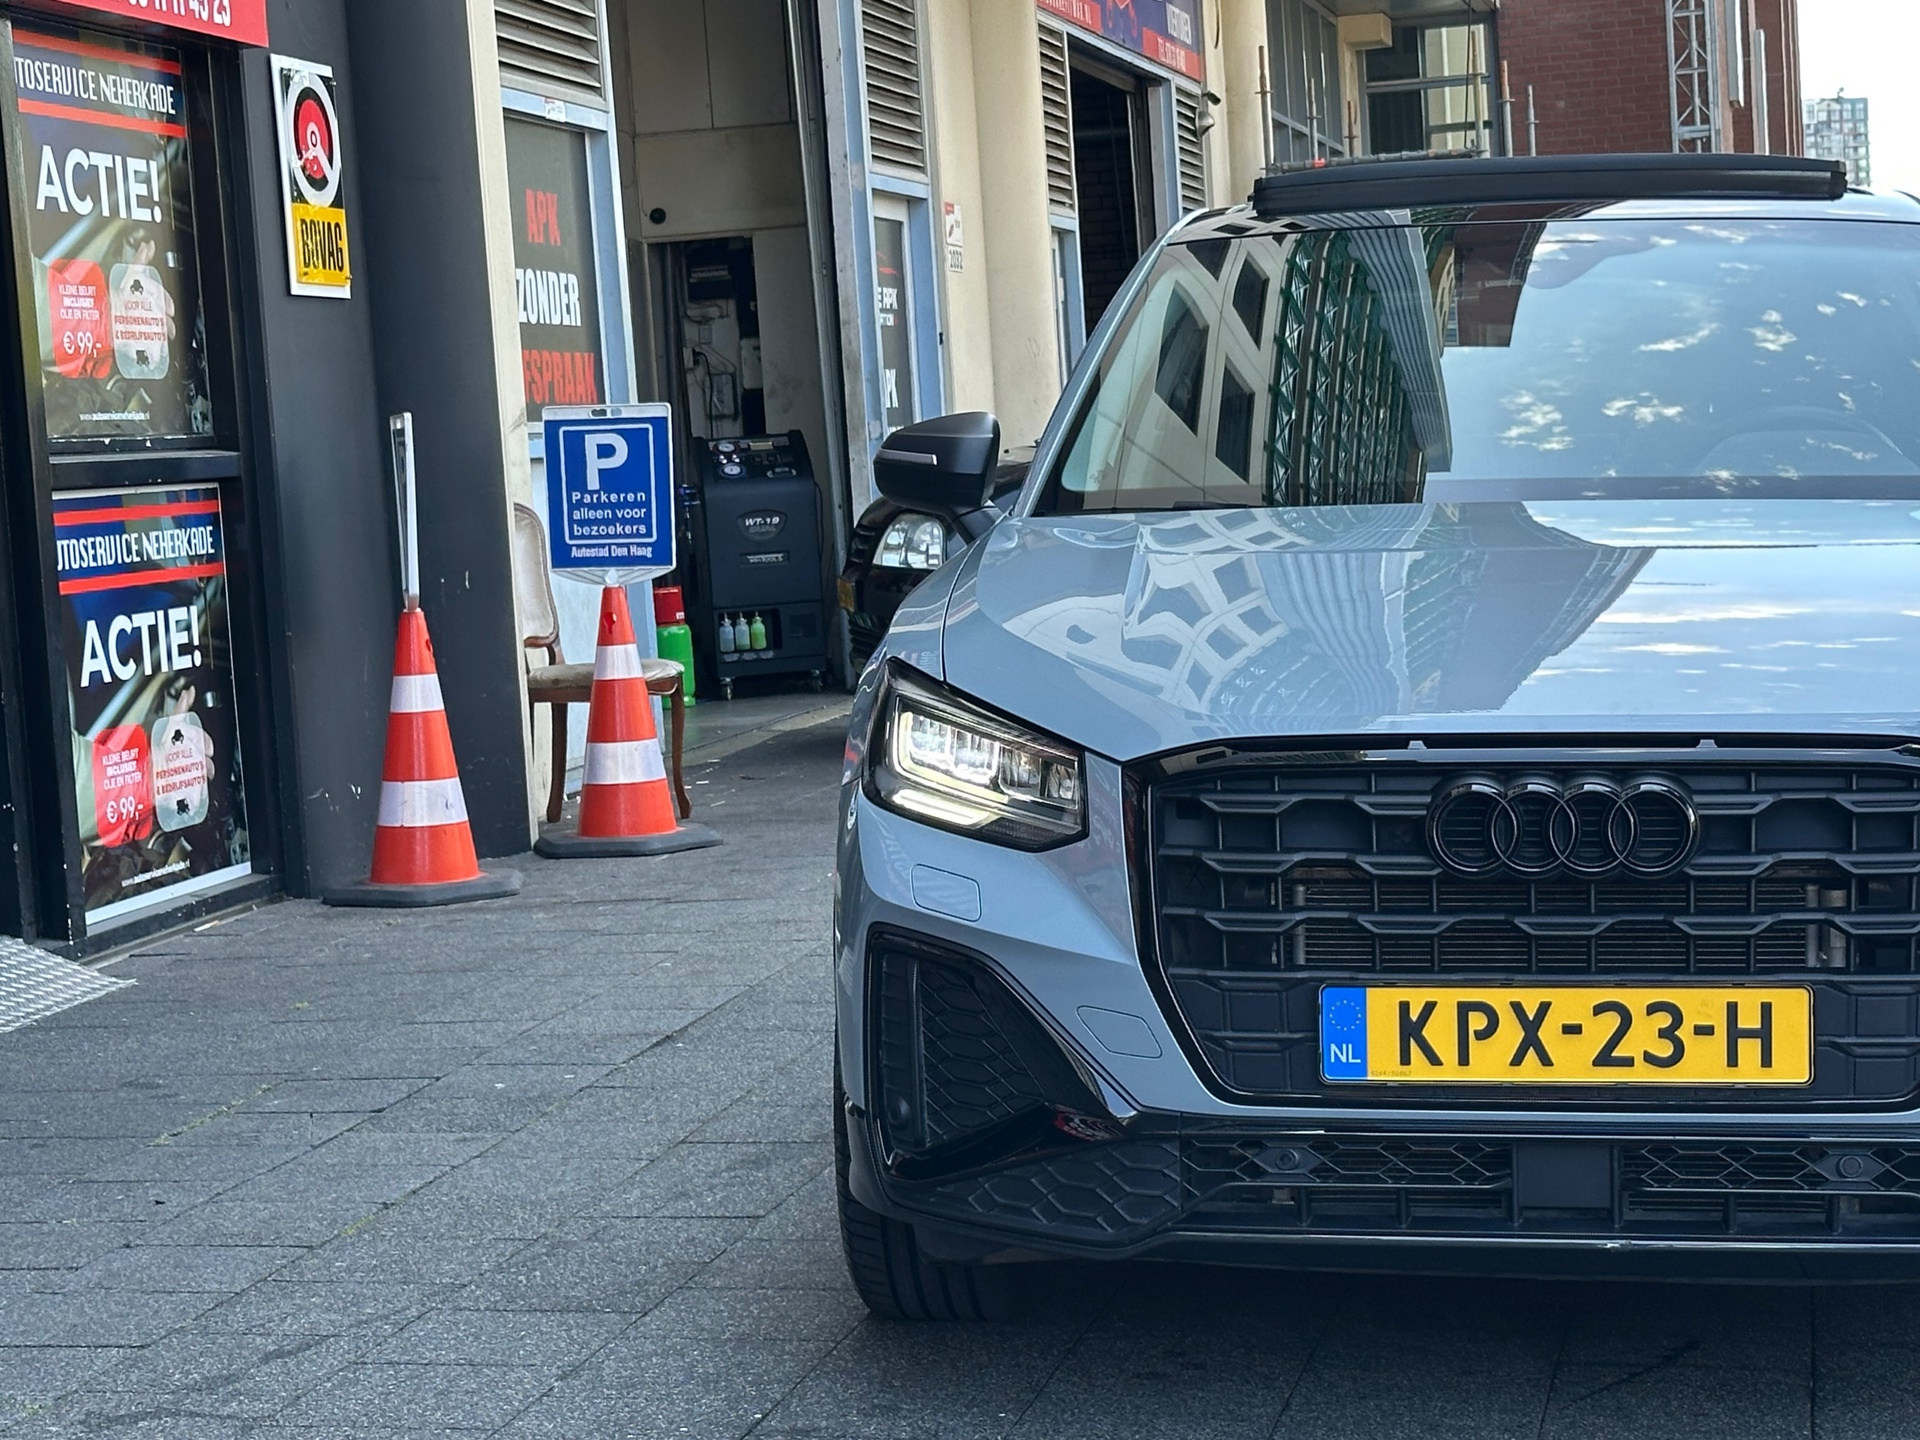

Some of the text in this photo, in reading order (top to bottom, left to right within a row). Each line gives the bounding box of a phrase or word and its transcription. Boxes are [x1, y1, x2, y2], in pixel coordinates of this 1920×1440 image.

[99, 72, 176, 115] NEHERKADE
[36, 145, 162, 224] ACTIE!
[525, 188, 561, 246] APK
[300, 218, 344, 273] BOVAG
[515, 268, 582, 326] ZONDER
[63, 331, 75, 355] €
[584, 433, 629, 491] P
[571, 490, 646, 504] Parkeren
[572, 507, 647, 520] alleen voor
[142, 525, 215, 561] NEHERKADE
[573, 523, 647, 536] bezoekers
[571, 545, 652, 558] Autostad Den Haag
[80, 605, 202, 688] ACTIE!
[122, 748, 139, 761] BEURT
[106, 800, 118, 824] €
[1330, 1000, 1773, 1068] NL KPX-23-H
